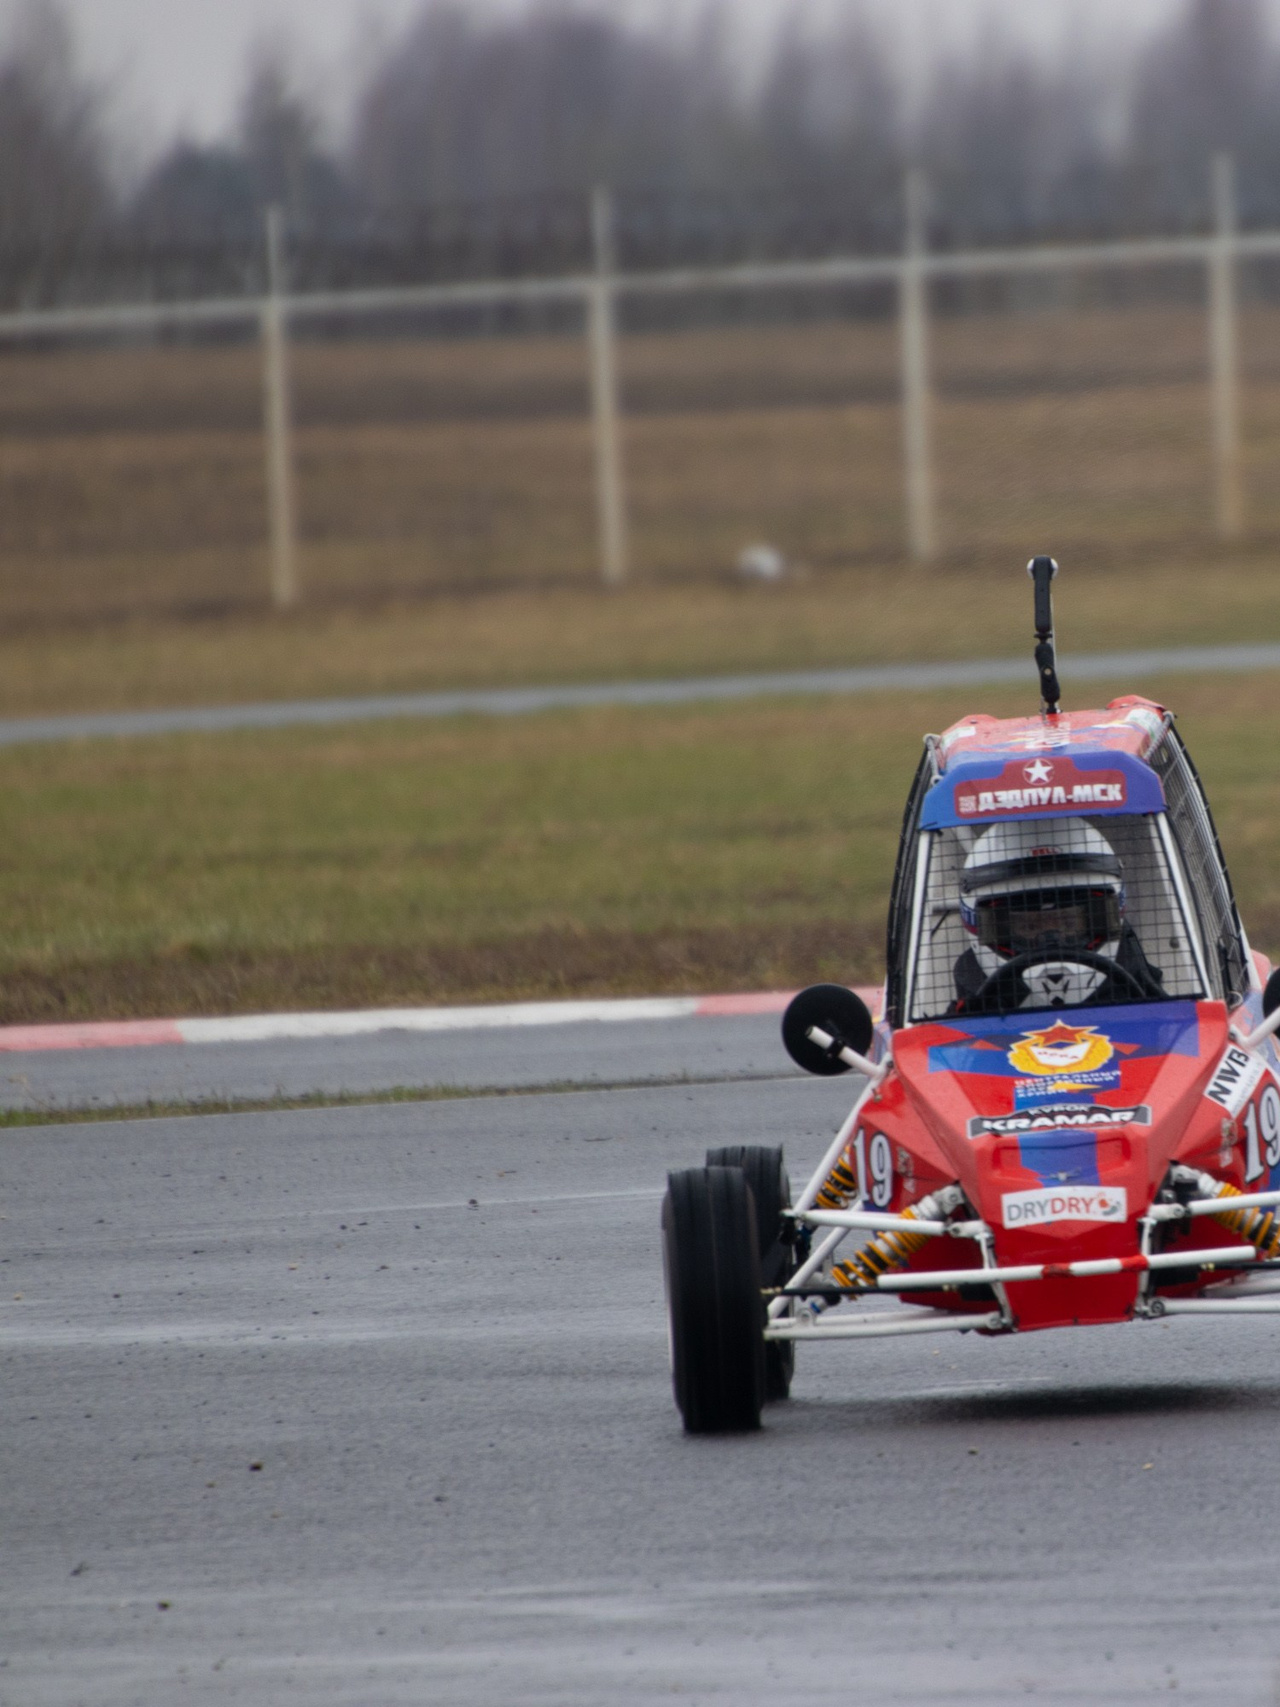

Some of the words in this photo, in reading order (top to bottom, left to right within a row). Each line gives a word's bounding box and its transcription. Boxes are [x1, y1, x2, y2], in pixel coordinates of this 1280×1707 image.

[1208, 1048, 1250, 1105] NWB
[982, 1111, 1135, 1130] KRAMAR
[853, 1126, 893, 1208] 19
